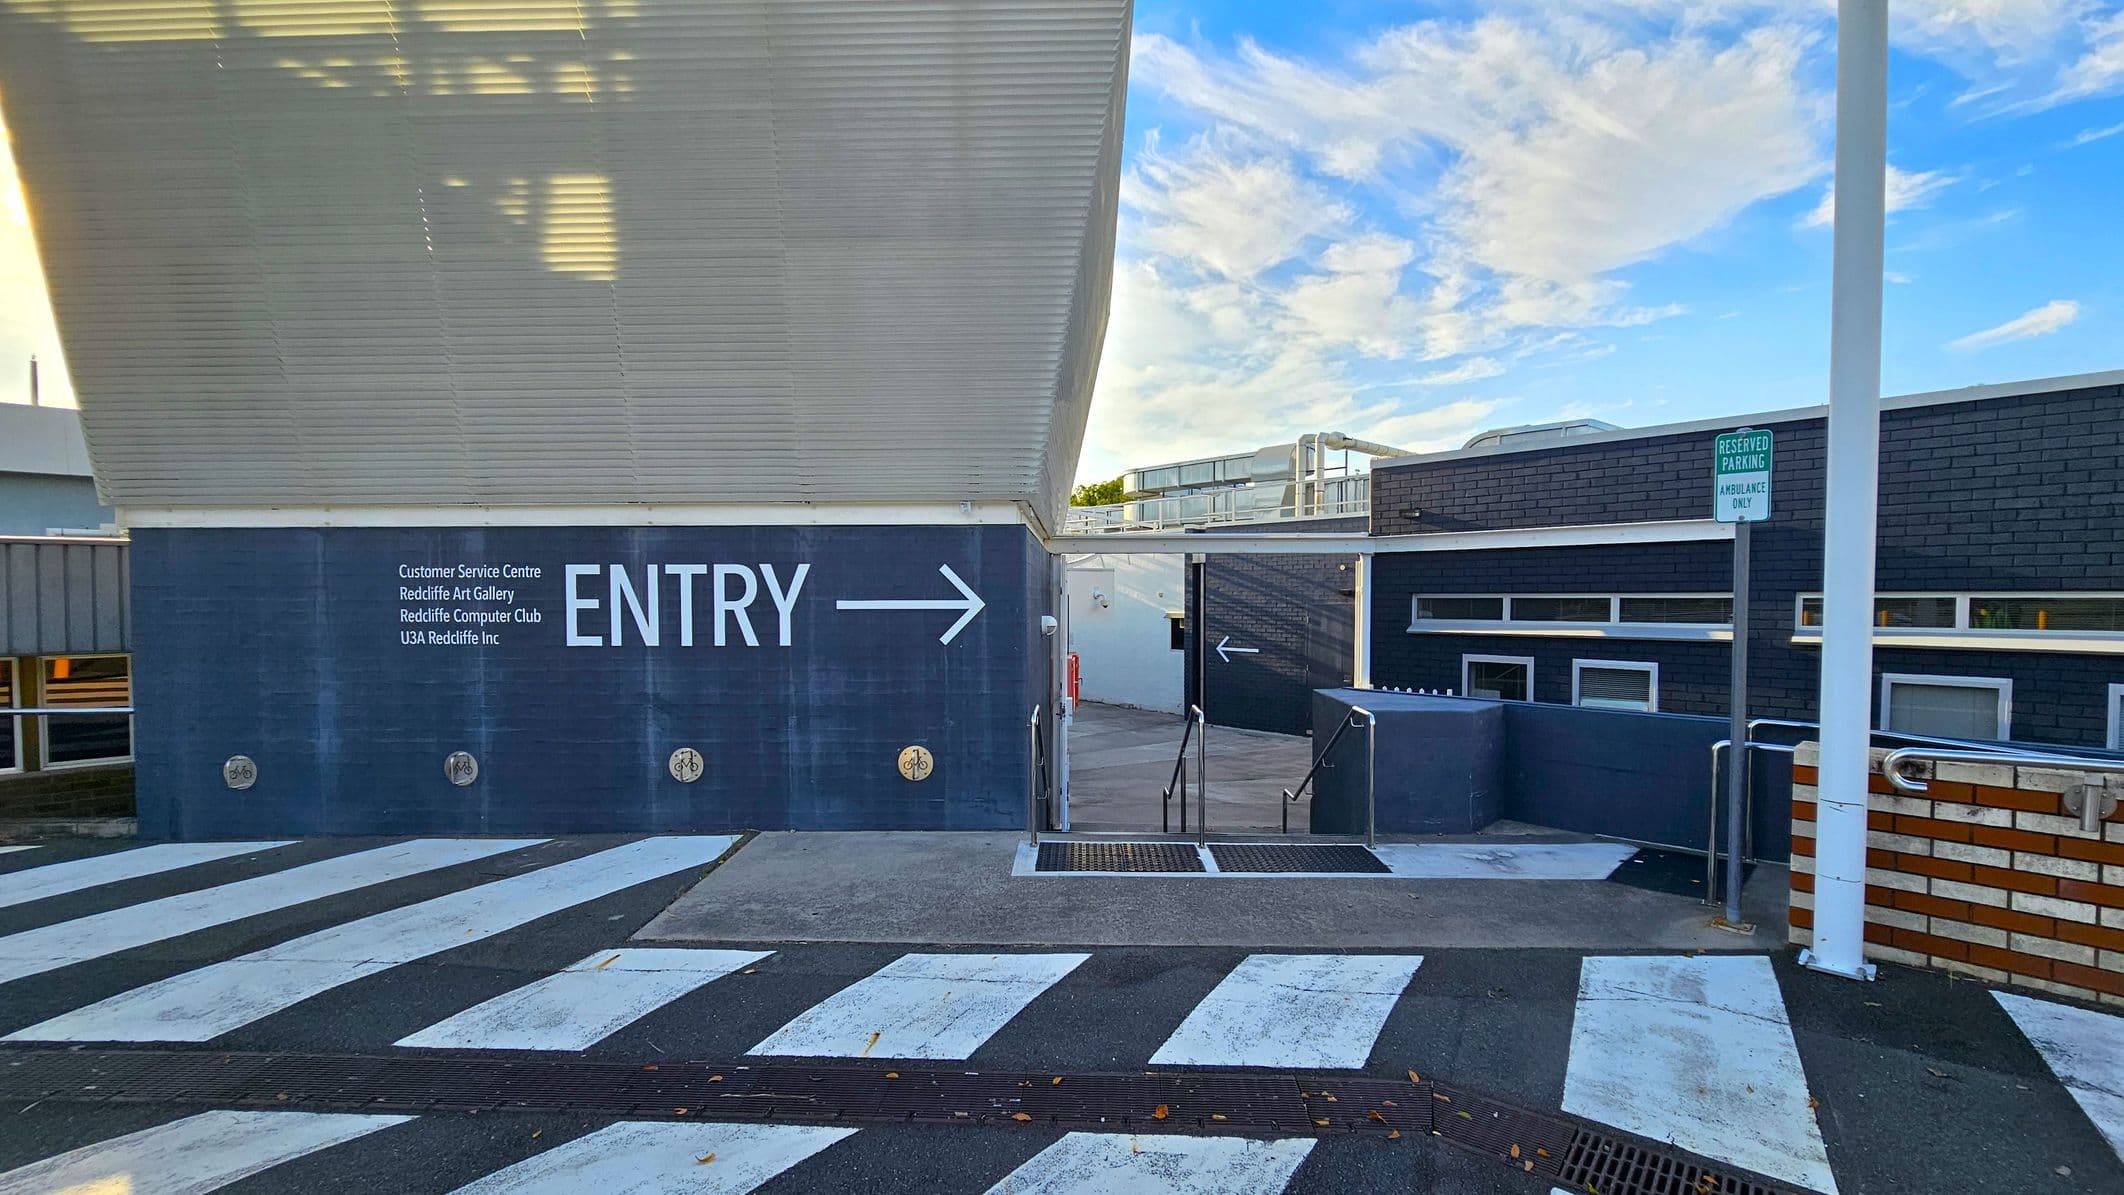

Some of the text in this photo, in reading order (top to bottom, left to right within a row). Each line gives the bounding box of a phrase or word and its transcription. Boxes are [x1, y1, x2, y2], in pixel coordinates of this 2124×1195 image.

[1719, 436, 1768, 454] RESERVED
[1722, 454, 1765, 471] PARKING
[1720, 482, 1766, 495] AMBULANCE
[1732, 497, 1752, 509] ONLY
[398, 563, 542, 579] Customer Service Centre
[400, 585, 515, 605] Redcliffe Art Gallery
[564, 563, 811, 647] ENTRY
[400, 607, 542, 627] Redcliffe Computer Club
[400, 629, 500, 645] U3A Redcliffe Inc
